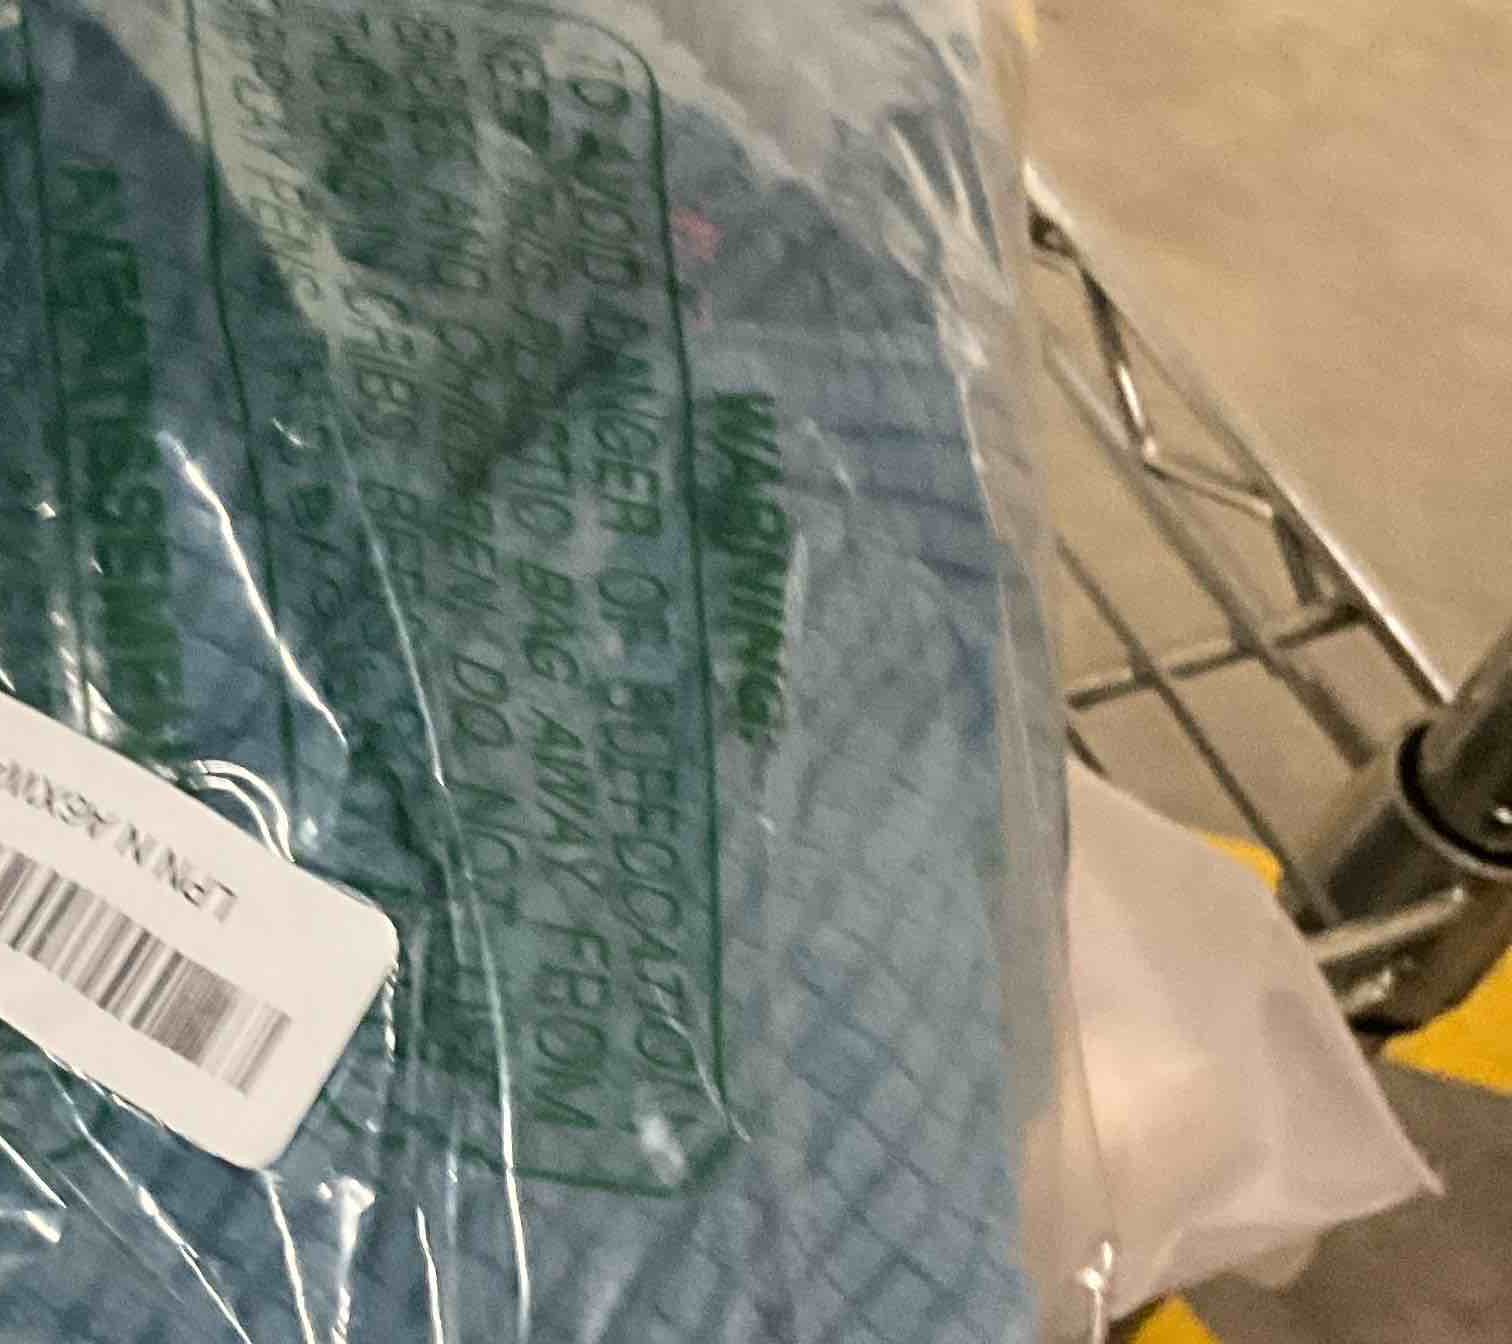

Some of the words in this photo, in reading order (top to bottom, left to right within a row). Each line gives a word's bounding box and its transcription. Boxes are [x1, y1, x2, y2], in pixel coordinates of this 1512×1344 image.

[512, 558, 582, 688] BAG
[597, 568, 672, 646] OF
[447, 651, 512, 751] DO
[441, 774, 522, 930] NOT
[525, 706, 601, 898] AWAY
[522, 918, 612, 1134] FROM
